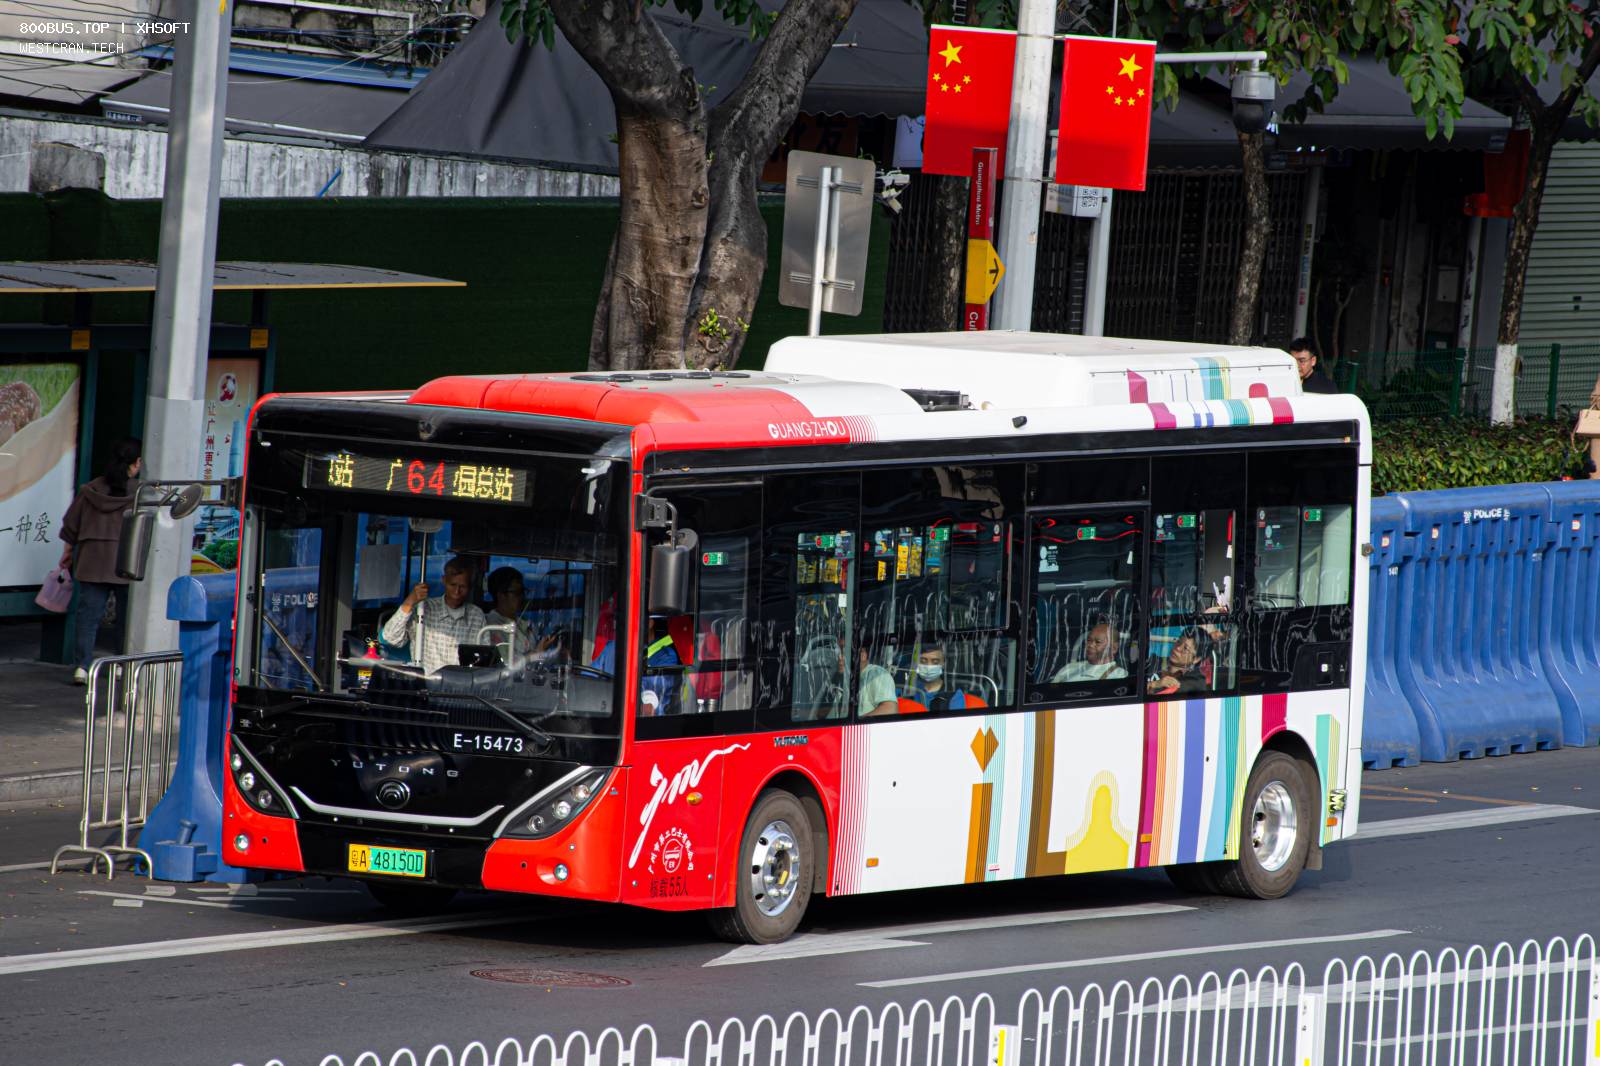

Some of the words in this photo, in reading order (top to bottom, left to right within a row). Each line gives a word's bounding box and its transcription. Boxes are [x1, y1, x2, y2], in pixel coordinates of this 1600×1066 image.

[975, 161, 984, 202] Guangzhou
[768, 421, 846, 438] GUANGZHOU
[407, 460, 445, 496] 64
[1473, 508, 1502, 519] POLICE
[453, 733, 523, 753] E-15473
[330, 759, 459, 778] YUTONG
[373, 851, 424, 872] 48150D
